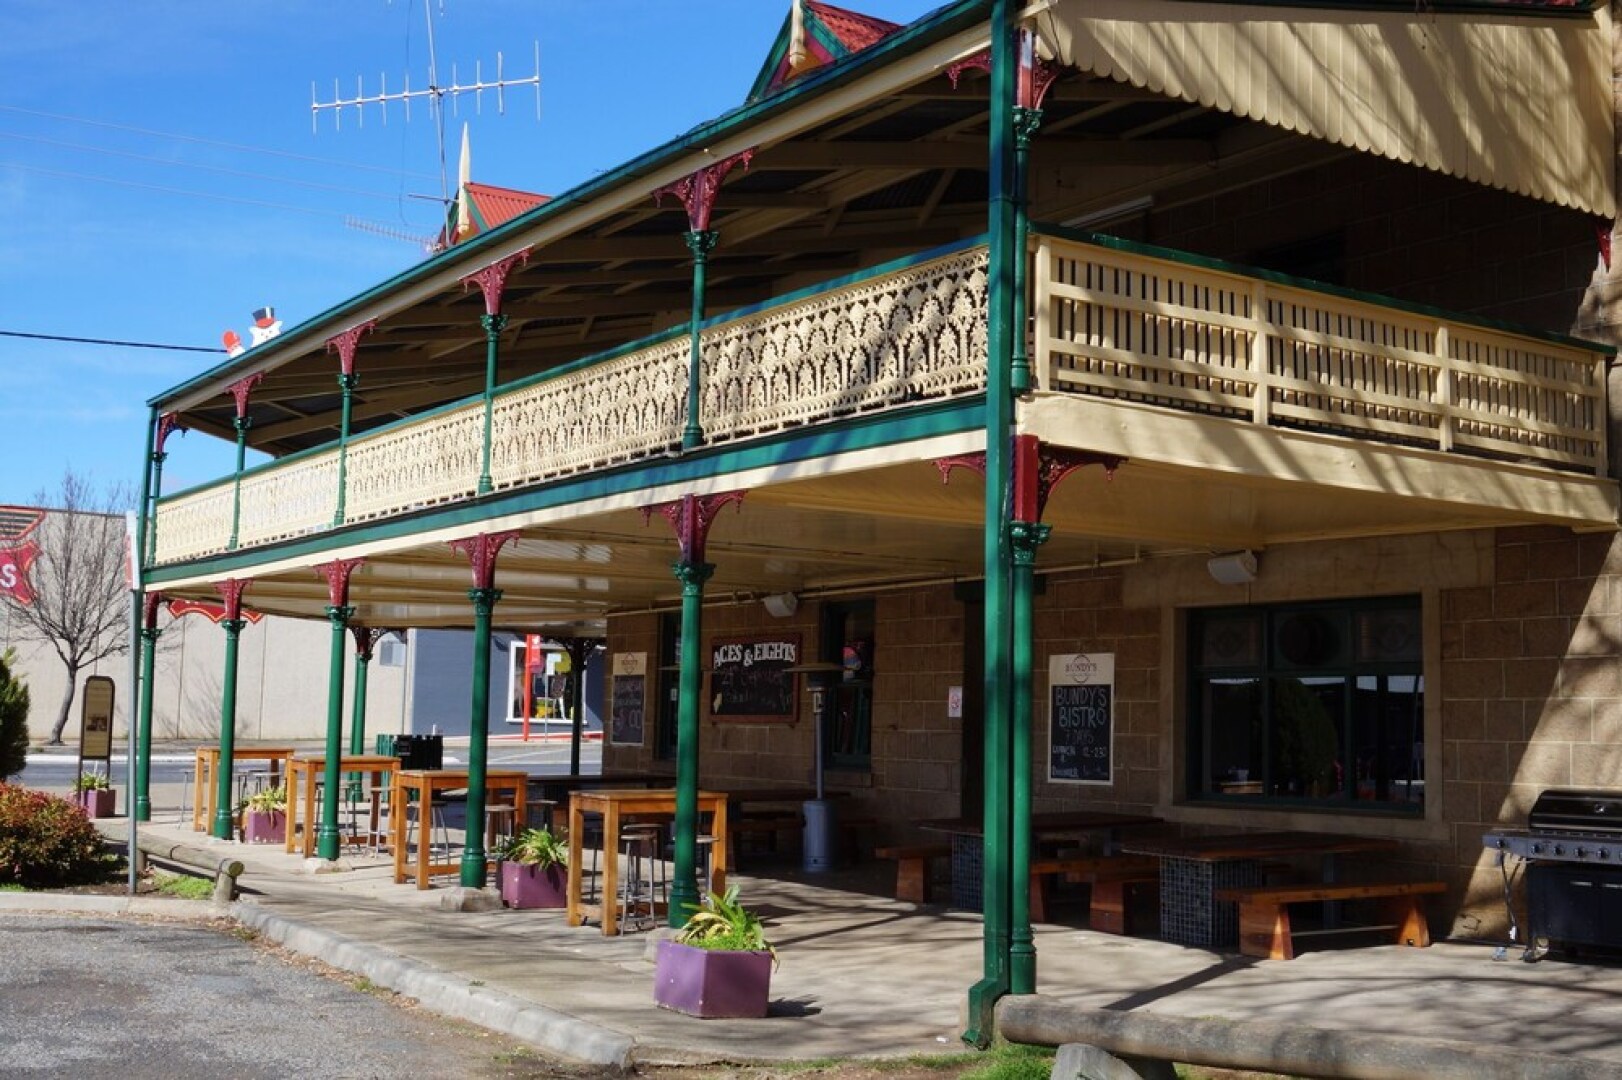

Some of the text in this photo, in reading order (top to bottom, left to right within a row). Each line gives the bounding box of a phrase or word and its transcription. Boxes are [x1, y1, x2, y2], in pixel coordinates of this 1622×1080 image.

[714, 641, 796, 669] ACES & EIGHTS
[1055, 687, 1107, 708] BUNDY'S
[1058, 706, 1107, 728] BISTRO
